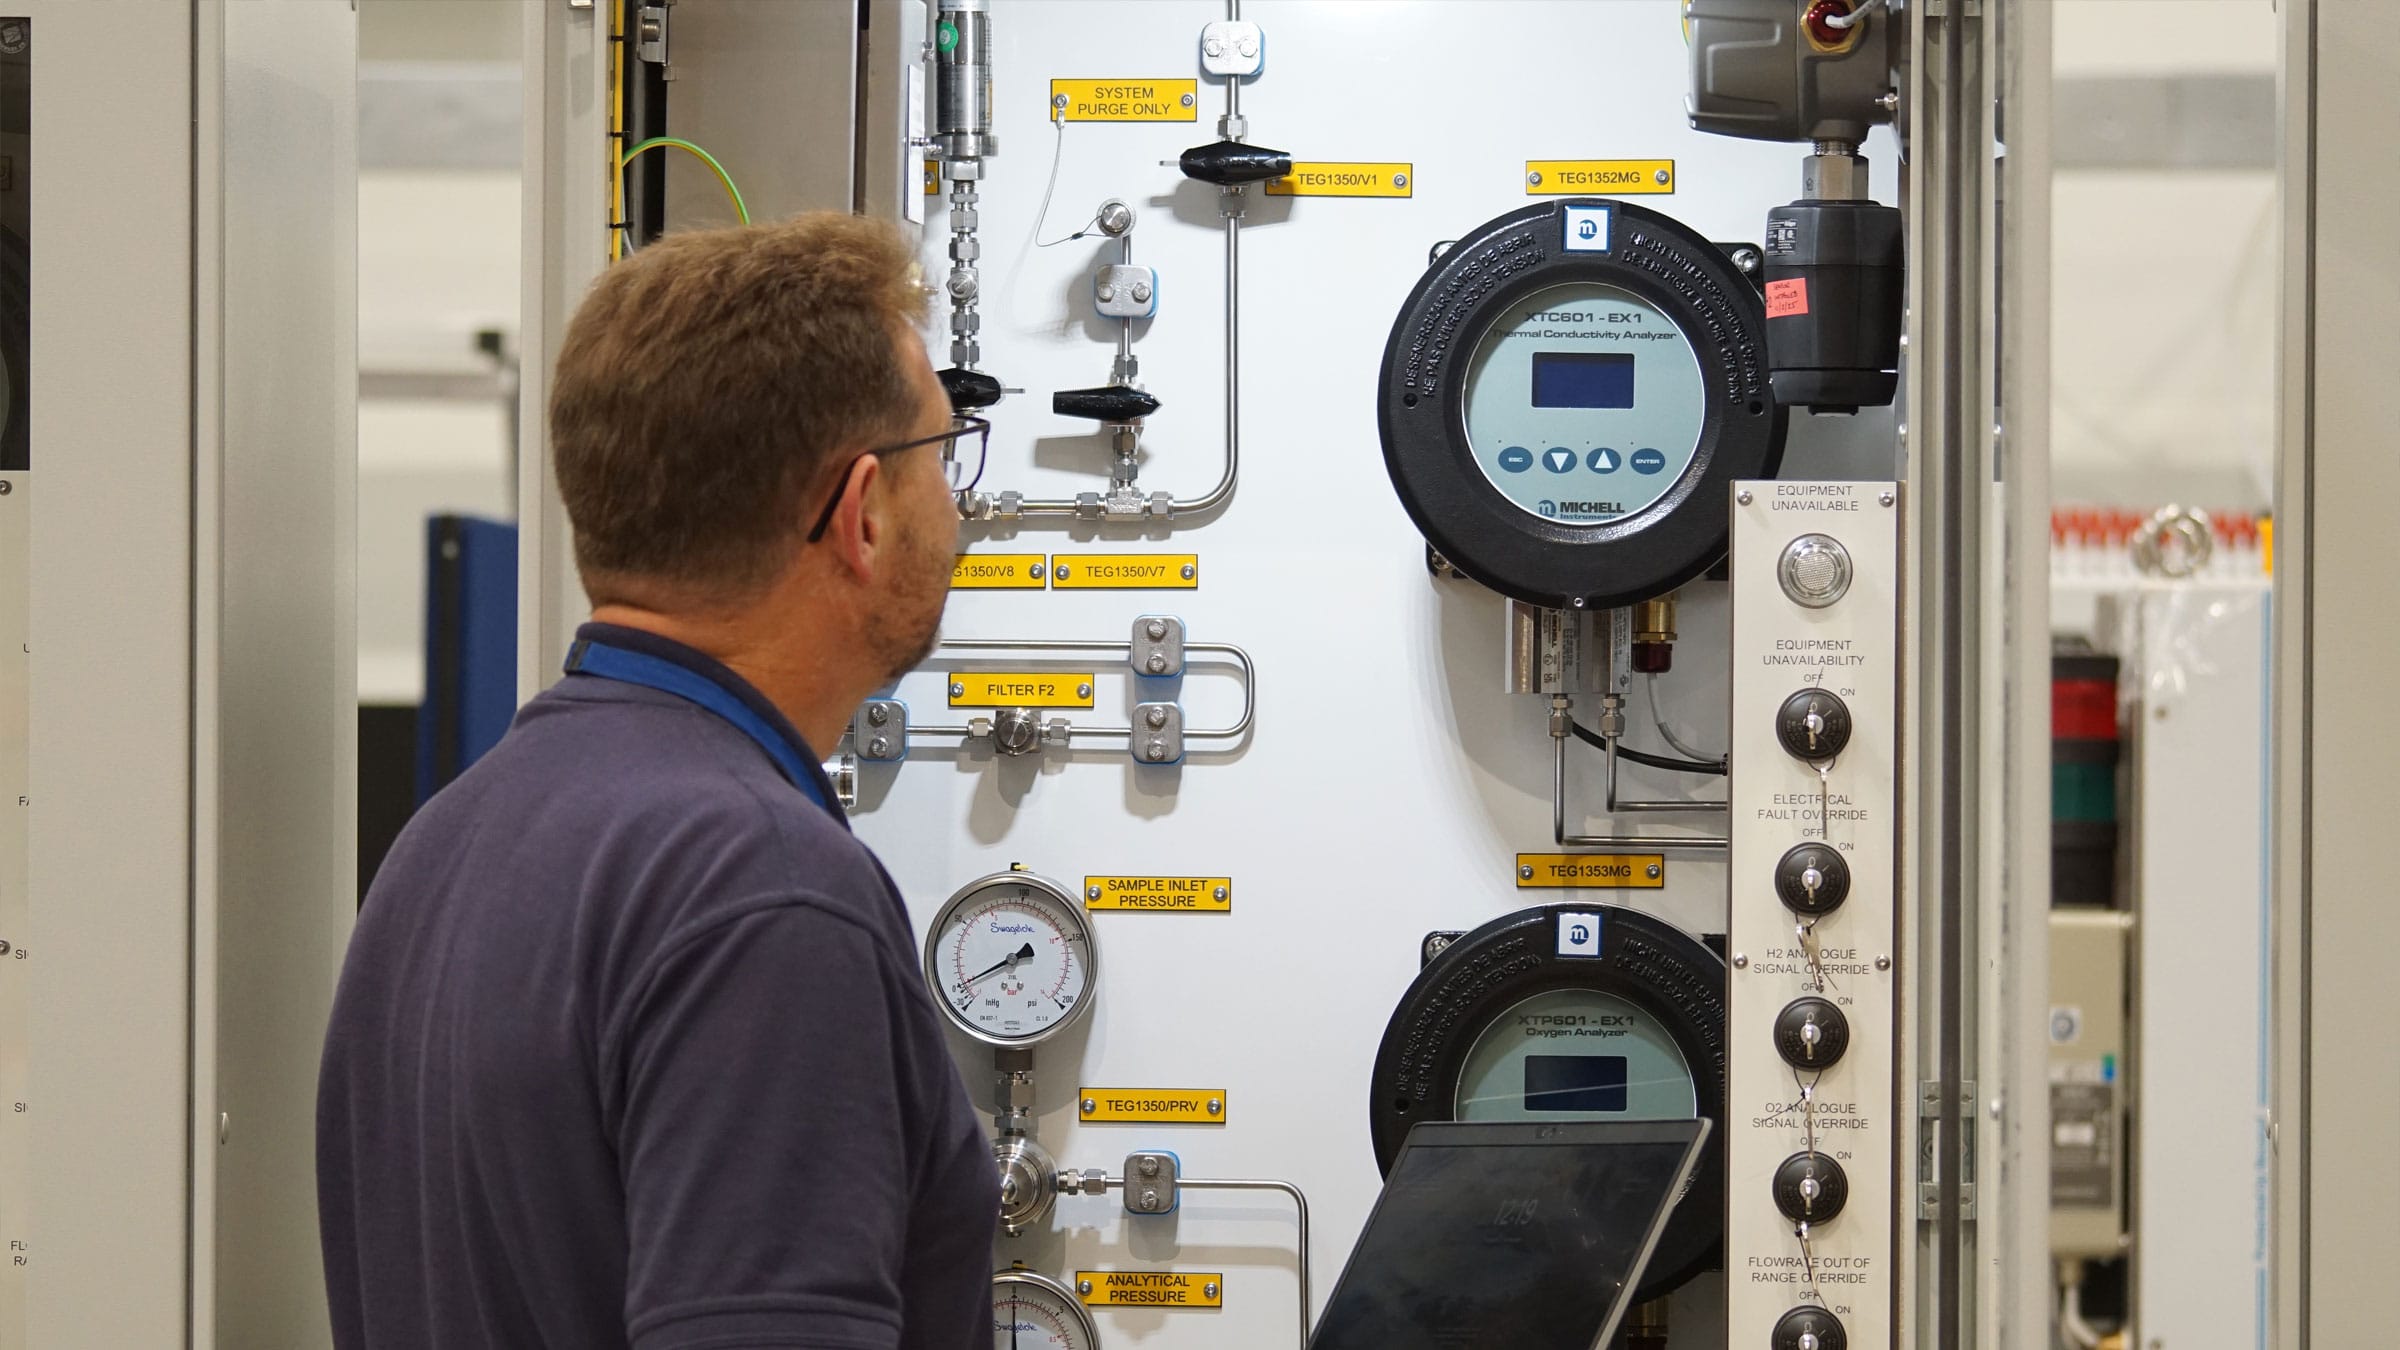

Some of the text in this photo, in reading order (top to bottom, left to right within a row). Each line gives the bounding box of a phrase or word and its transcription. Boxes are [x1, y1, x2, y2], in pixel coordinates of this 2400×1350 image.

[1093, 87, 1155, 99] SYSTEM
[1077, 103, 1171, 116] PURGE ONLY
[1297, 173, 1378, 187] TEG1350/V1
[1557, 172, 1641, 185] TEG1352MG
[1524, 312, 1594, 323] XTC601
[1608, 313, 1642, 323] EX1
[1493, 330, 1676, 341] Thermal Conductivity Analyzer
[1777, 486, 1852, 496] EQUIPMENT
[1560, 502, 1625, 513] MICHELL
[1772, 501, 1859, 511] UNAVAILABLE
[953, 565, 1014, 577] G1350/V8
[1085, 566, 1166, 578] TEG1350/V7
[1776, 640, 1852, 650] EQUIPMENT
[1763, 656, 1864, 665] UNAVAILABILITY
[1803, 674, 1824, 682] OFF
[987, 684, 1055, 696] FILTER F2
[1840, 688, 1855, 696] ON
[1773, 794, 1852, 805] ELECTRCAL
[1758, 809, 1798, 819] FAULT
[1802, 828, 1823, 837] OFF
[1839, 842, 1854, 851] ON
[1548, 866, 1632, 877] TEG1353MG
[1108, 880, 1208, 892] SAMPLE INLET
[1119, 895, 1196, 907] PRESSURE
[990, 922, 1036, 935] Swagelok
[1767, 948, 1857, 959] H2 ANOGUE
[1753, 964, 1870, 974] SIGNAL OERRIDE
[1801, 983, 1819, 991] OF
[1838, 997, 1853, 1005] ON
[1518, 1015, 1586, 1026] XTP601
[1601, 1016, 1634, 1026] EX1
[1526, 1028, 1628, 1038] Oxygen Analyzer
[1106, 1100, 1198, 1112] TEG1350/PRV
[1765, 1103, 1782, 1112] O2
[1753, 1118, 1869, 1129] SIGNAL OVERRIDE
[1800, 1137, 1821, 1145] OF
[1836, 1151, 1851, 1159] ON
[1749, 1257, 1870, 1268] FLOWRAE OUT OF
[1105, 1275, 1190, 1287] ANALYTICAL
[1752, 1272, 1797, 1283] RANGE
[1109, 1291, 1186, 1303] PRESSURE
[1836, 1306, 1851, 1314] ON
